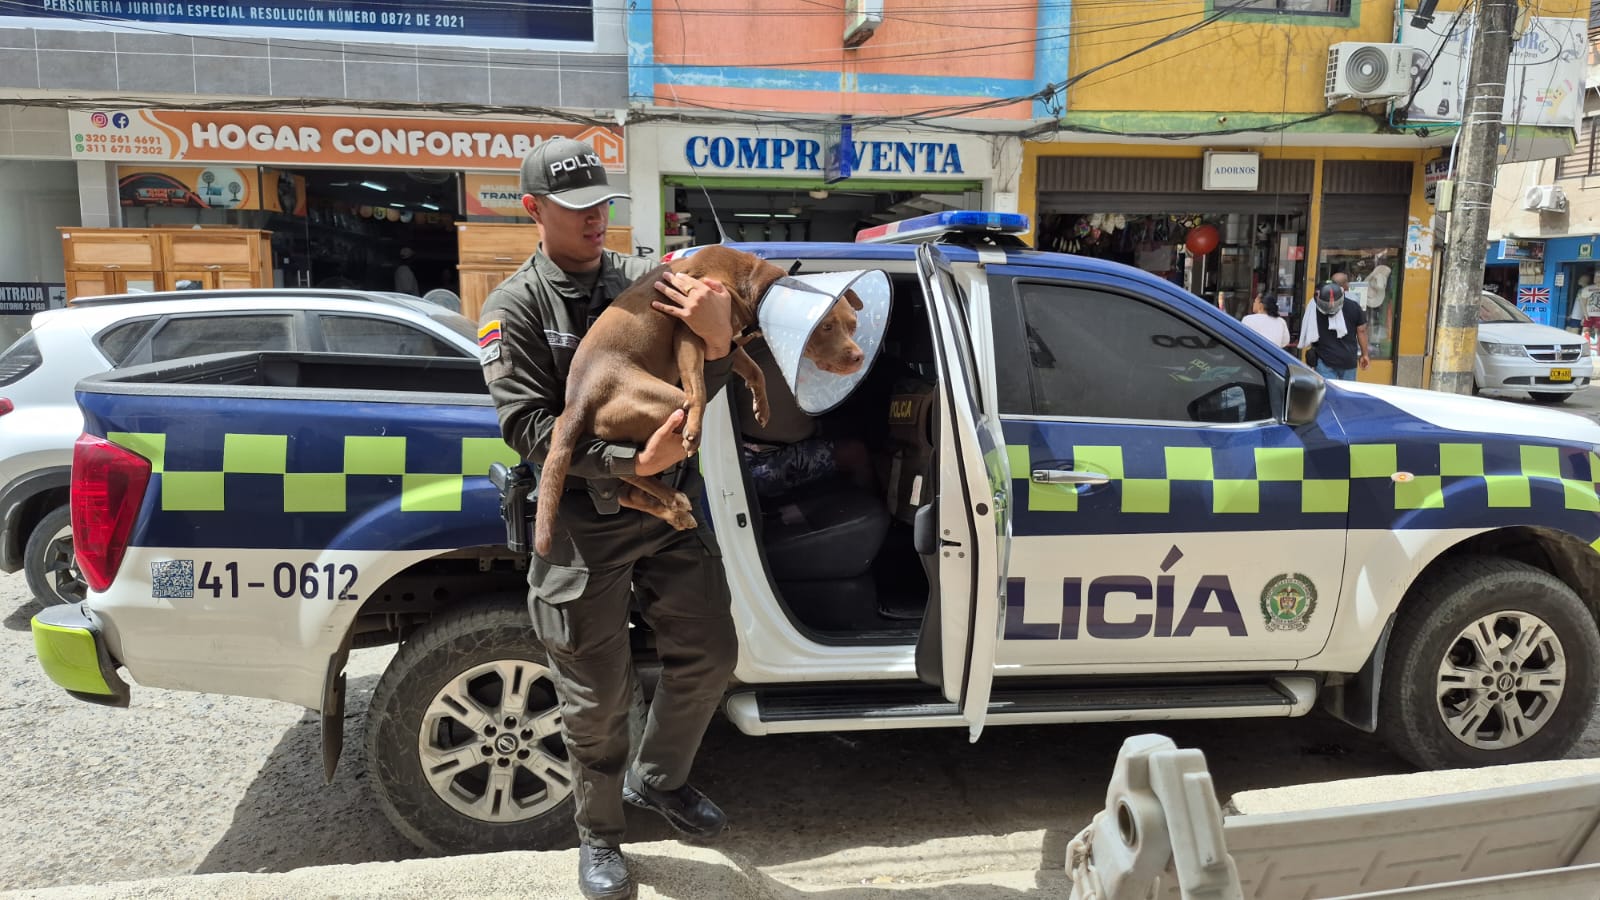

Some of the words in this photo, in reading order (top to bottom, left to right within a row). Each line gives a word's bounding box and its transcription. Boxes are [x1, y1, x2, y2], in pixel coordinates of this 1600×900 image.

[44, 0, 122, 14] PERSONERIA
[127, 3, 184, 16] JURIDICA
[187, 5, 246, 19] ESPECIAL
[250, 6, 323, 22] RESOLUCIÓN
[328, 8, 376, 24] NÚMERO
[381, 12, 412, 26] 0872
[416, 14, 431, 26] DE
[435, 15, 465, 28] 2021
[85, 133, 107, 142] 320
[110, 135, 130, 143] 561
[134, 136, 161, 145] 4691
[191, 122, 321, 152] HOGAR
[332, 128, 542, 159] CONFORTAB
[86, 144, 107, 153] 311
[135, 146, 162, 155] 7302
[685, 135, 826, 171] COMPR
[851, 140, 964, 173] VENTA
[1215, 166, 1256, 175] ADORNOS
[25, 302, 30, 311] 2
[1003, 543, 1249, 640] LICÍA
